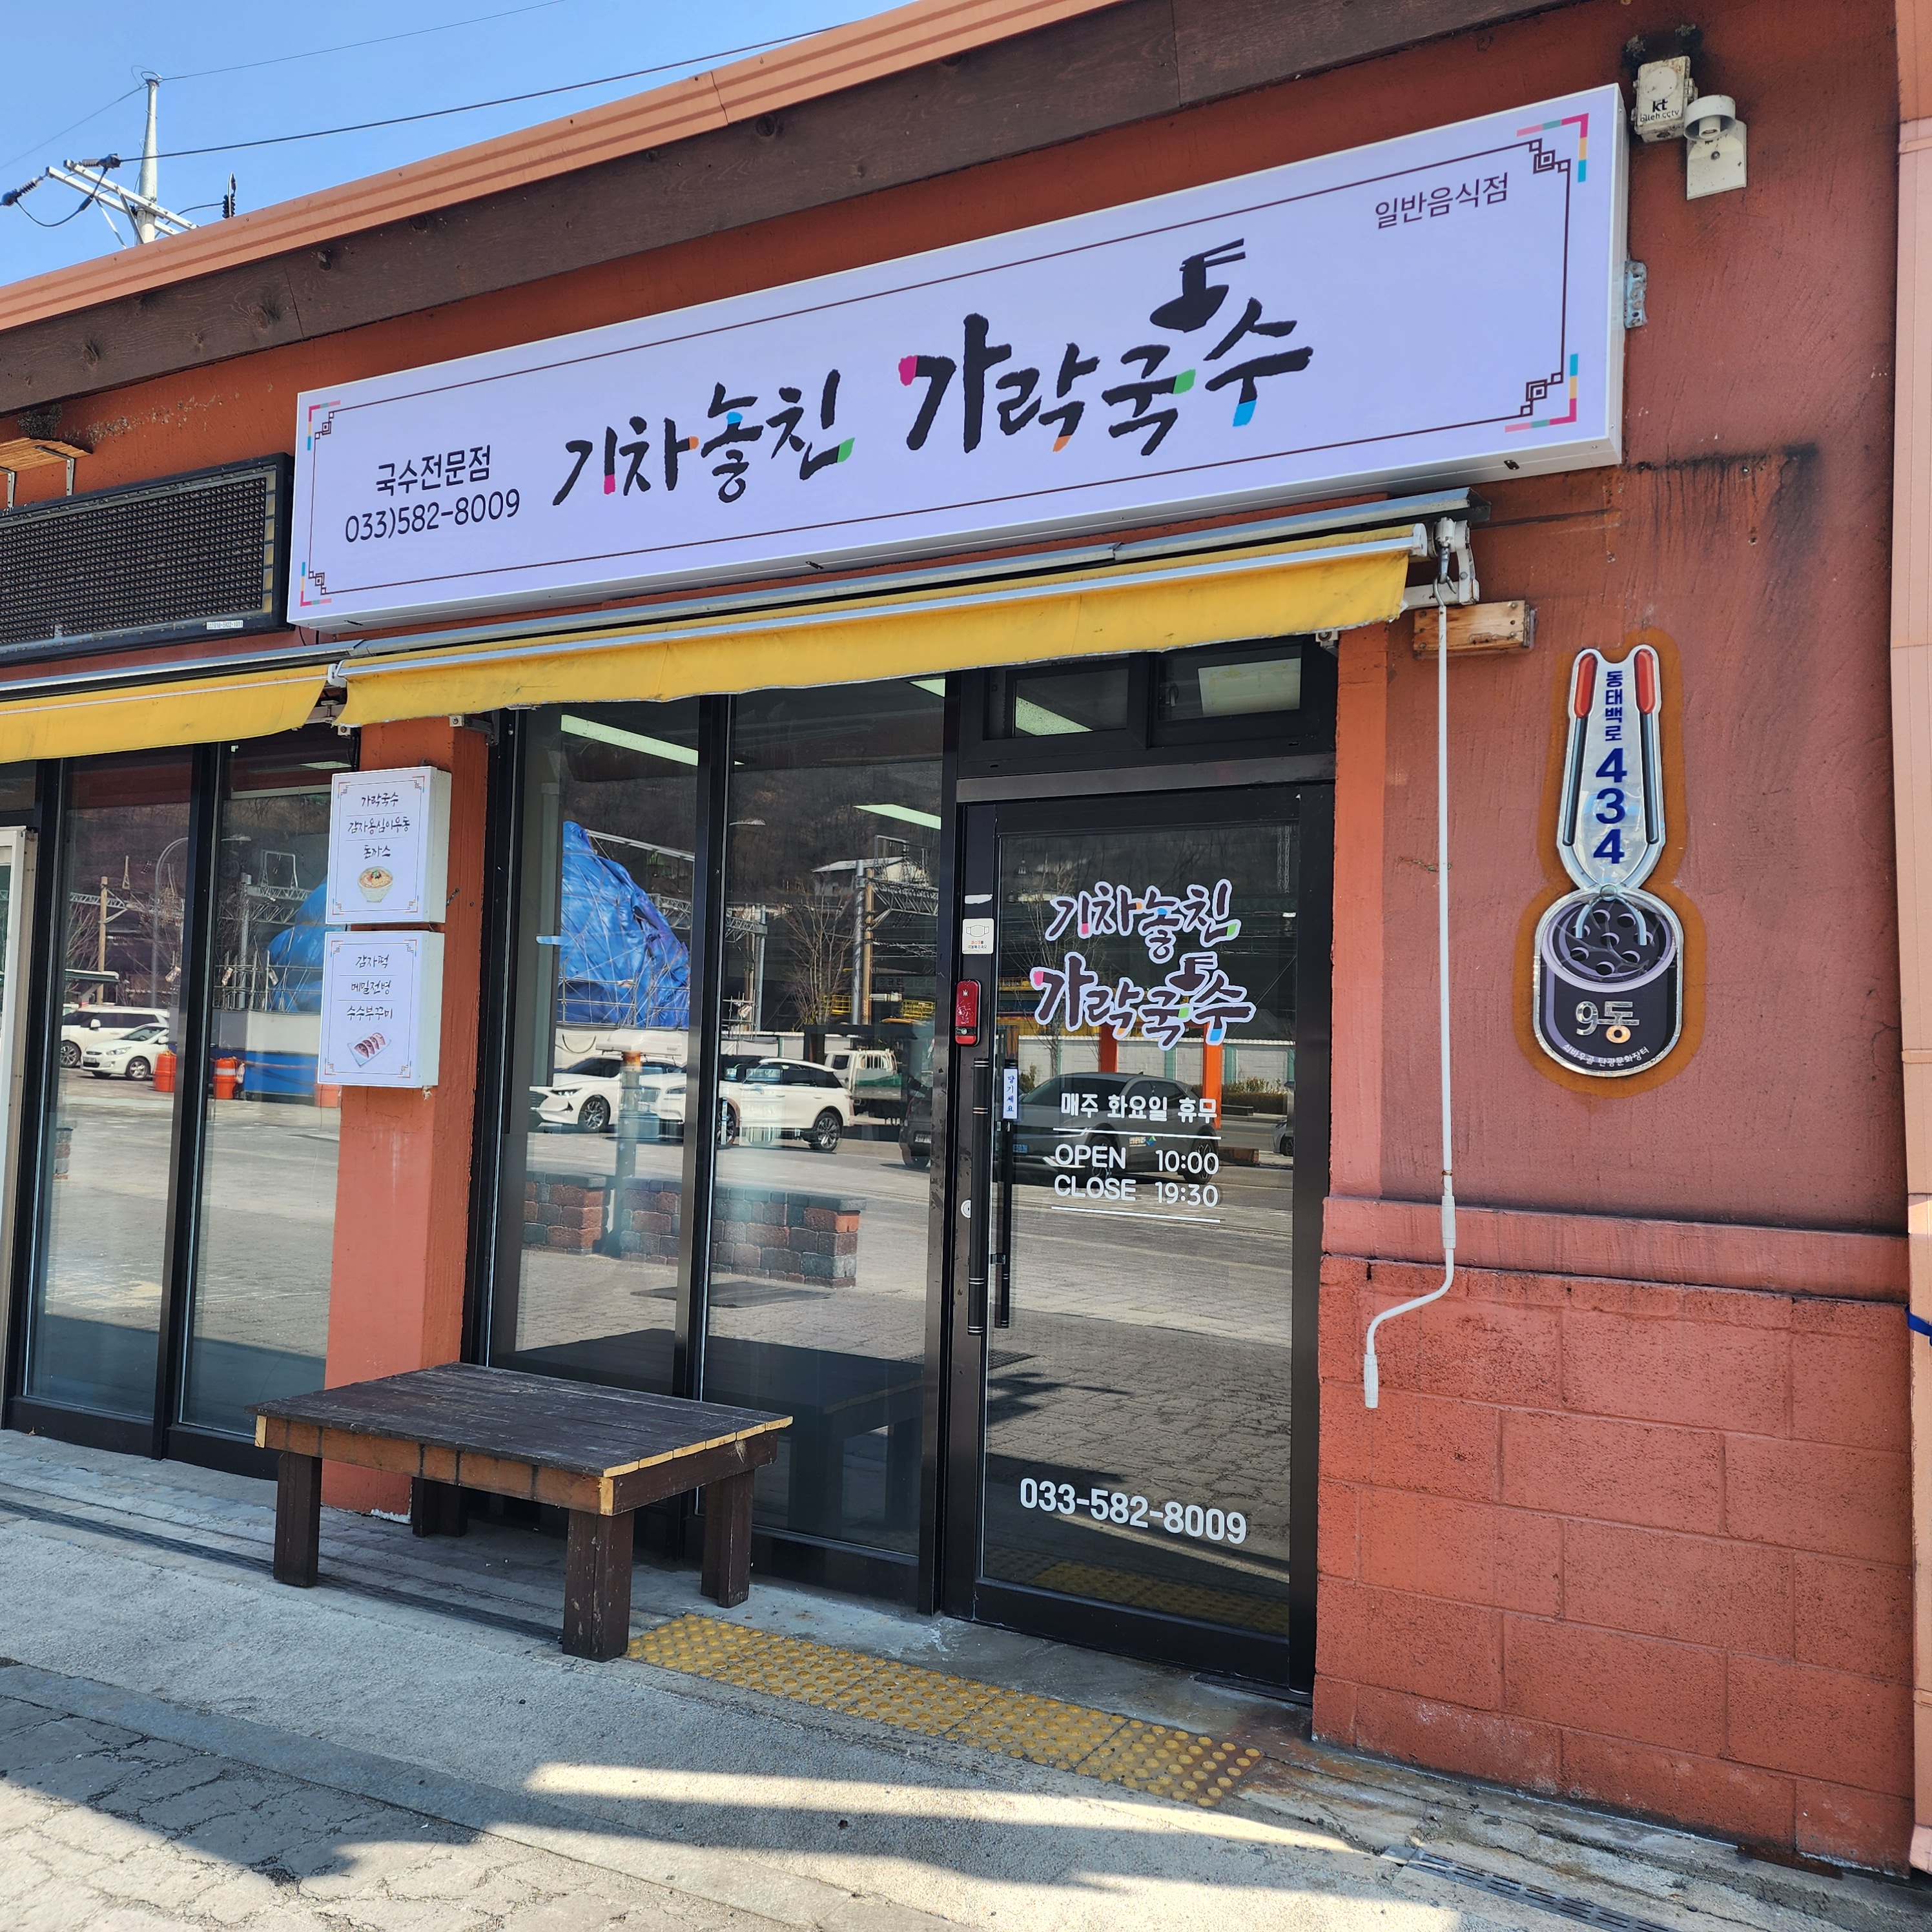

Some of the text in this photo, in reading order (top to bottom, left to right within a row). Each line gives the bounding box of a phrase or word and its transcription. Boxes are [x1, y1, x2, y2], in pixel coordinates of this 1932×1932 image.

[1639, 109, 1680, 123] olleh cctv
[1652, 99, 1669, 113] kt
[1375, 172, 1508, 229] 일반음식점
[552, 297, 1313, 506] 기차놓친 가락국수
[376, 445, 491, 497] 국수전문점
[345, 489, 520, 543] 033)582-8009
[1605, 670, 1623, 741] 동태백로
[361, 792, 398, 807] 가락국수
[1593, 748, 1627, 864] 434
[347, 817, 410, 835] 감자옹심이우동
[364, 845, 391, 859] 돈까스
[1045, 879, 1241, 963] 기차놓친
[355, 954, 389, 969] 감자떡
[351, 980, 391, 995] 메밀전병
[1031, 952, 1256, 1050] 가락국수
[347, 1005, 393, 1021] 수수부꾸미
[1576, 1001, 1639, 1043] 9동
[1598, 1046, 1650, 1067] 탄광문화장터
[1007, 1075, 1015, 1112] 당기세요
[1061, 1093, 1217, 1124] 매주 화요일 휴무
[1054, 1144, 1220, 1175] OPEN 10:00
[1054, 1174, 1220, 1208] CLOSE 19:30
[1020, 1477, 1247, 1545] 033-582-8009
